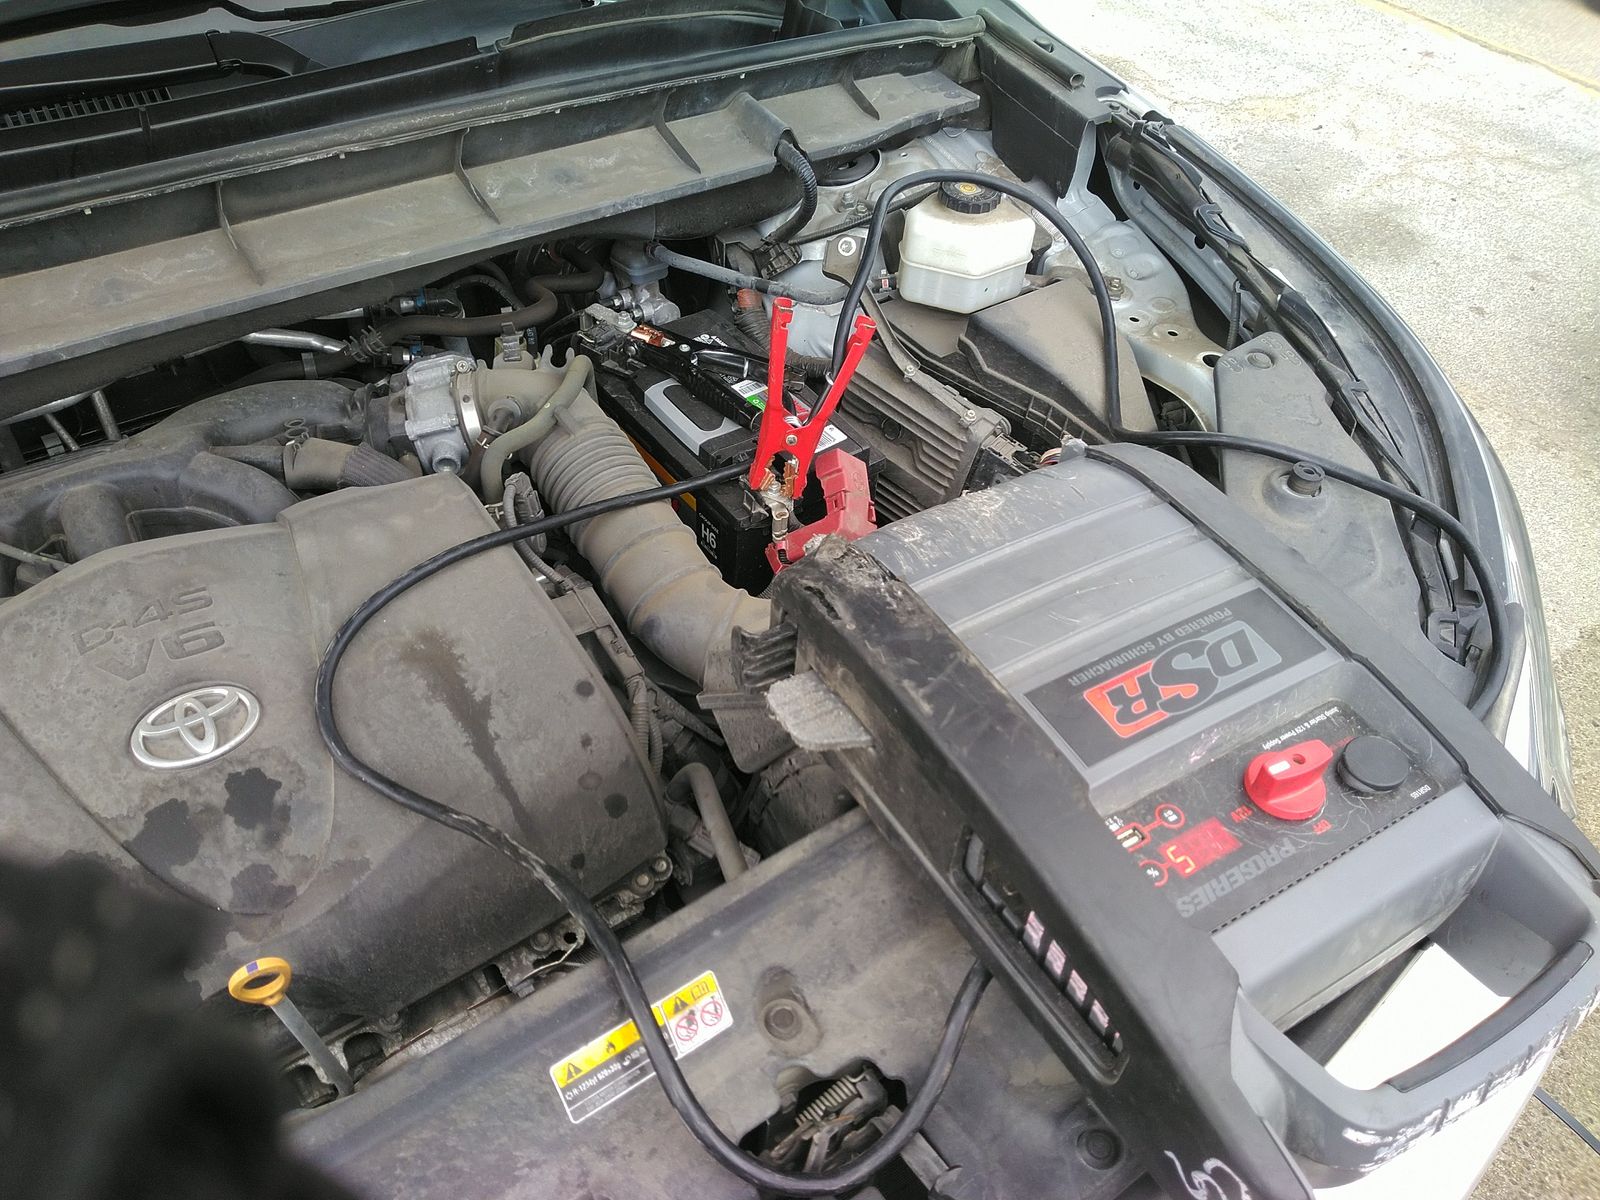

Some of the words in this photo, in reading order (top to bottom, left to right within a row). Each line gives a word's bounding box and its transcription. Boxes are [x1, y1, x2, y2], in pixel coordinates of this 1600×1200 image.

[701, 523, 717, 549] H6
[1176, 607, 1233, 640] POWERED
[94, 620, 226, 682] V6
[1157, 634, 1176, 647] BY
[1067, 641, 1157, 688] SCHUMACHER
[1102, 625, 1261, 727] DSR
[1262, 738, 1281, 750] Supply
[1280, 730, 1296, 740] Power
[1166, 844, 1196, 874] 5
[1175, 836, 1297, 919] PROSERIES
